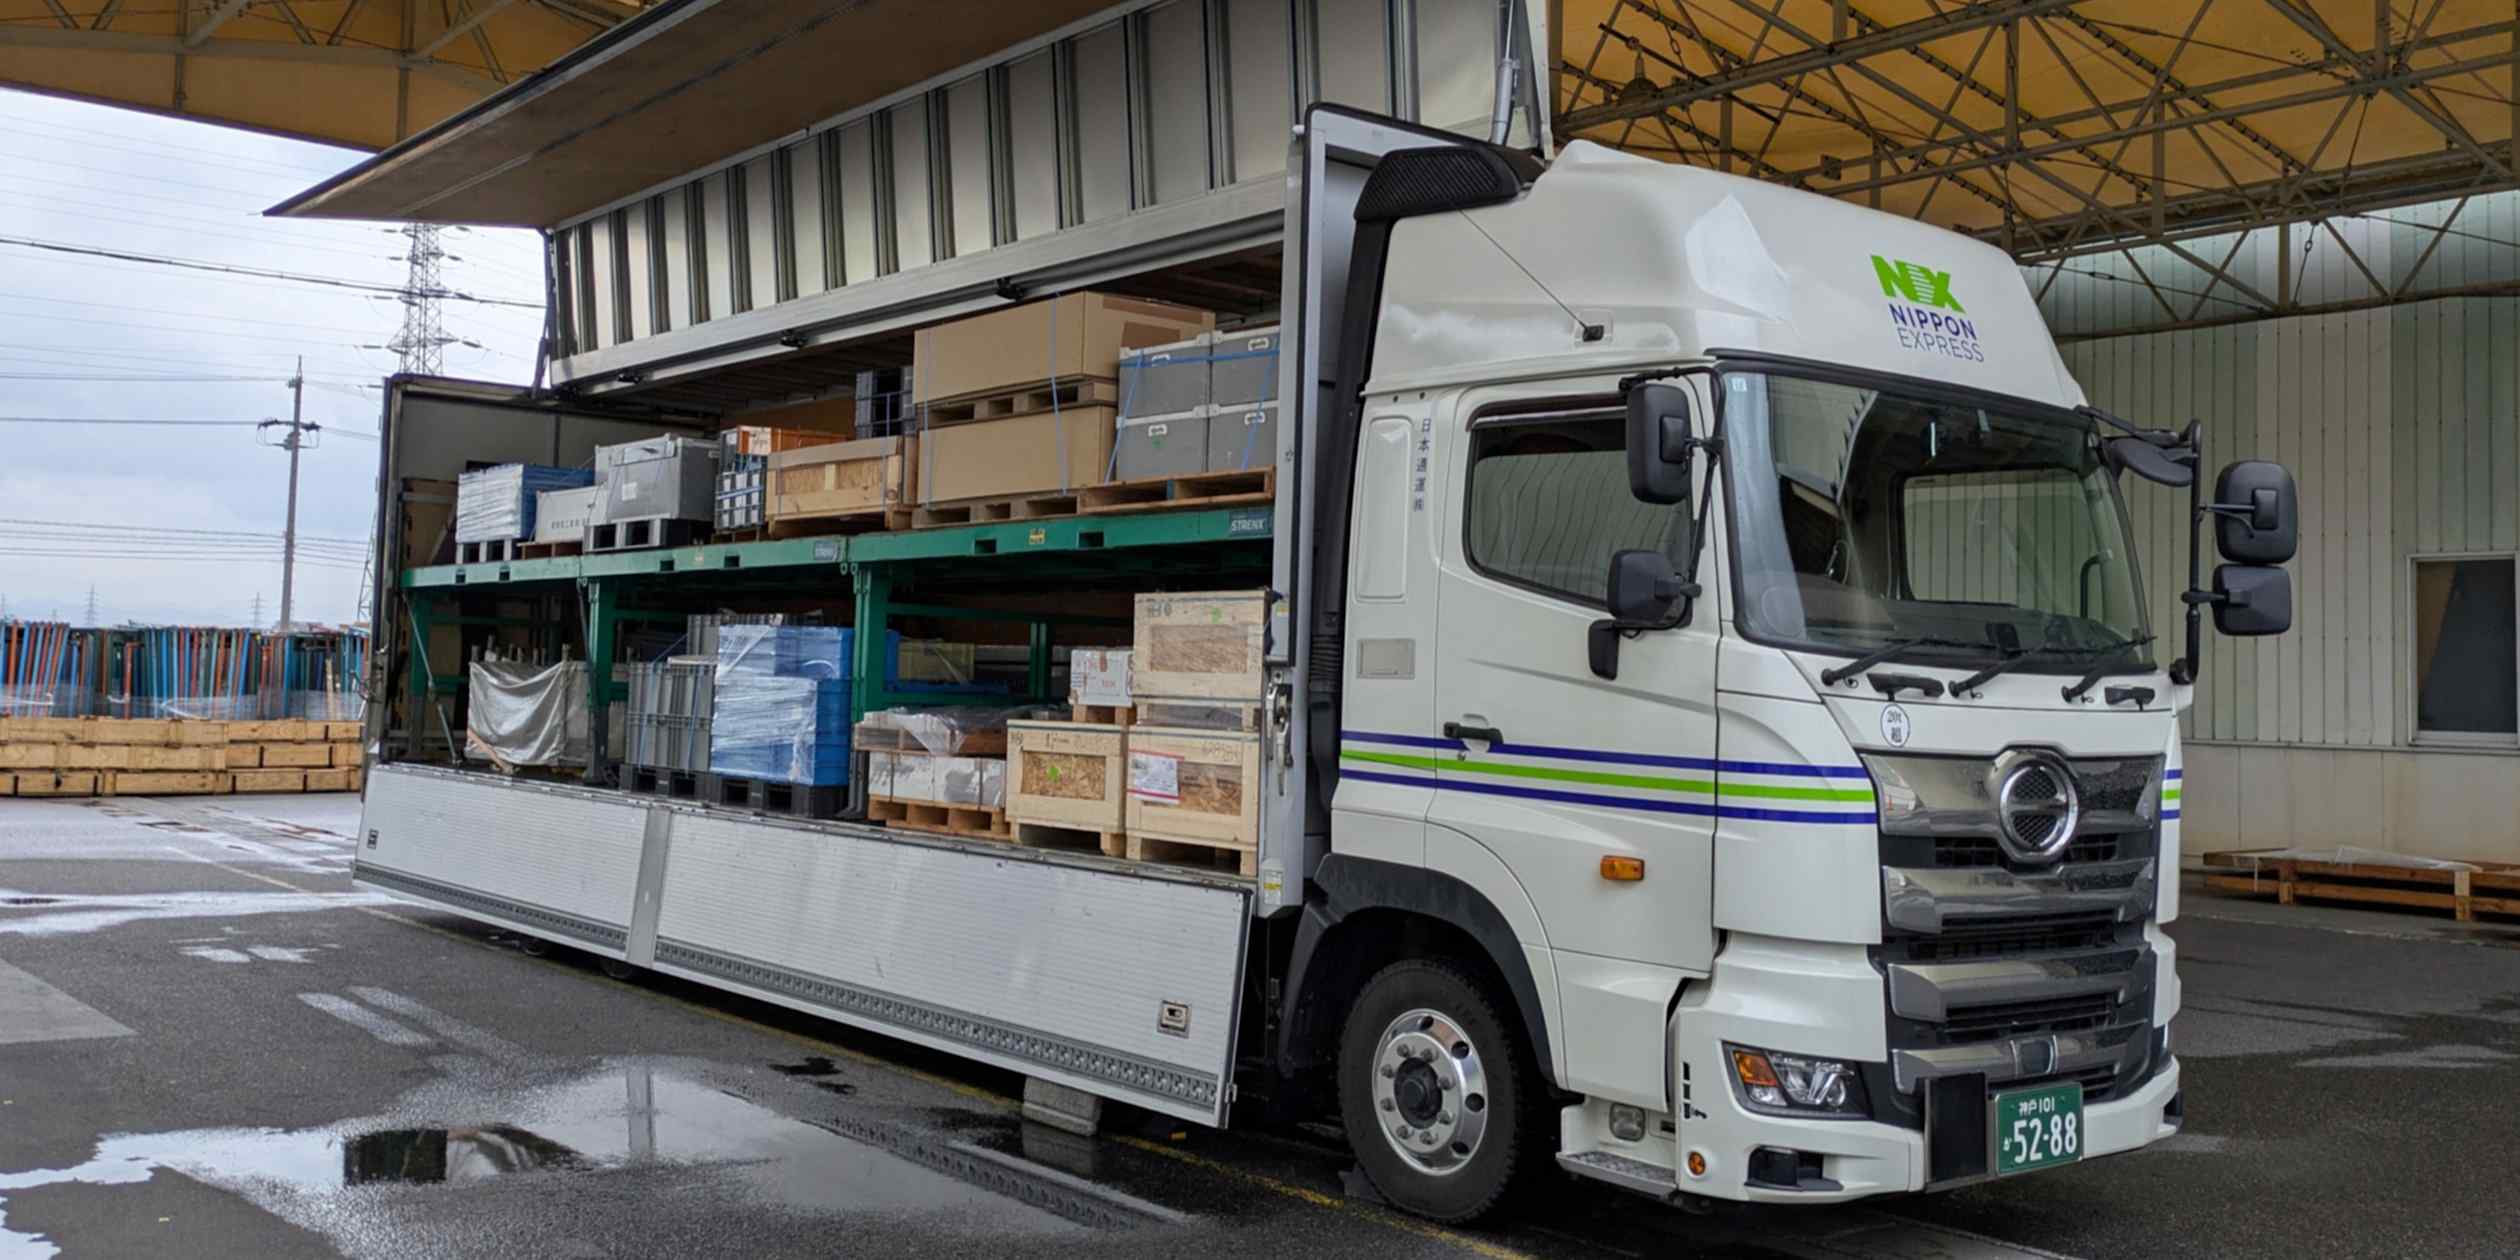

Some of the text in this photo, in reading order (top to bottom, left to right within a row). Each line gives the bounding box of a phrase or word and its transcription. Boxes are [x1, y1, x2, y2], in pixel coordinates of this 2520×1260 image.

[1889, 303, 1977, 341] NIPPON
[1897, 327, 1984, 362] EXPRESS
[2013, 1112, 2077, 1164] 52-88
